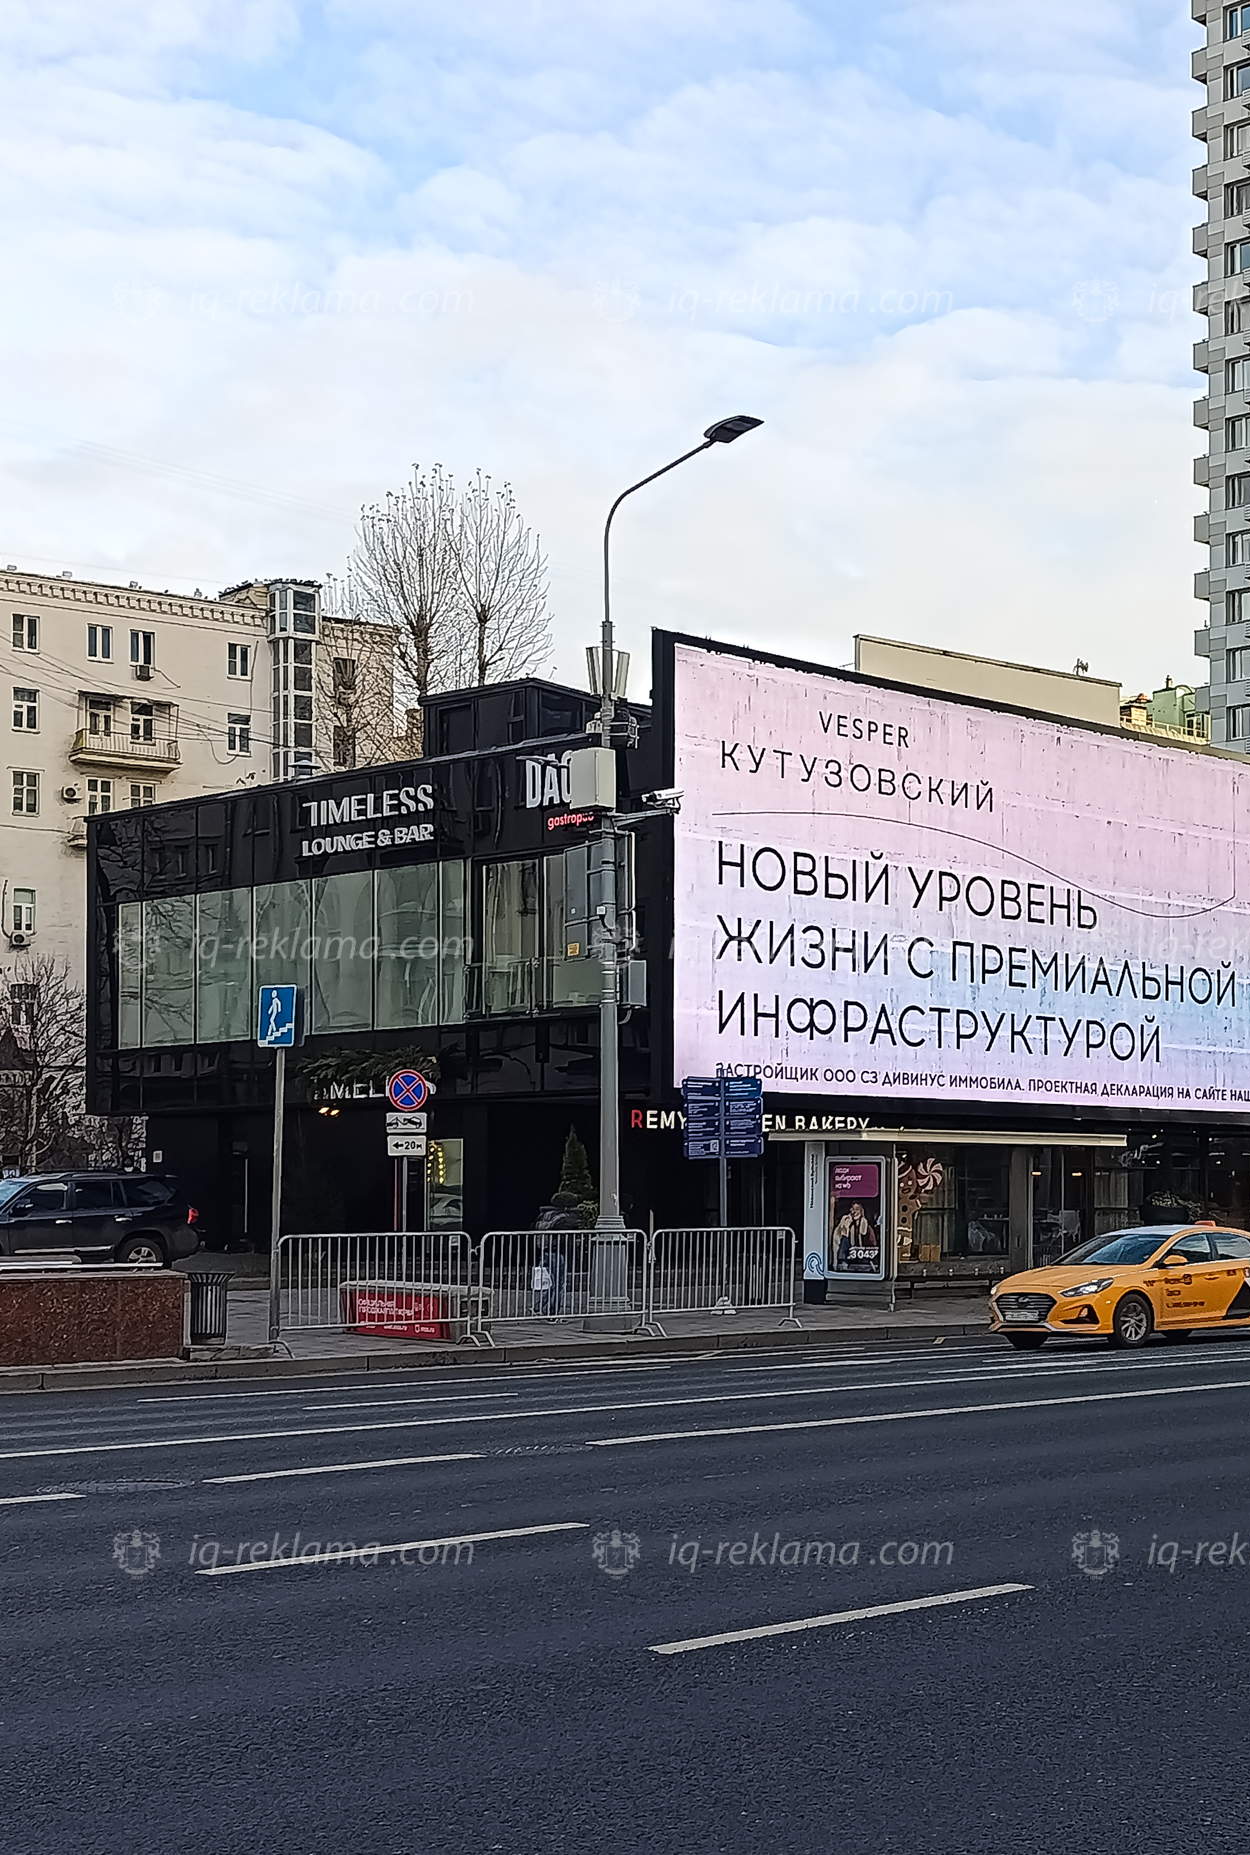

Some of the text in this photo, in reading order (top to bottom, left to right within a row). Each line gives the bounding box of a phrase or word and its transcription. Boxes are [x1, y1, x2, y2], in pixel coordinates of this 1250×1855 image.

[819, 711, 909, 748] VESPER
[720, 740, 994, 813] КУТУЗОВСКИЙ
[302, 784, 434, 827] TIMELESS
[302, 823, 435, 857] LOUNGE & BAR
[716, 839, 1098, 930] НОВЫЙ УРОВЕНЬ
[715, 914, 1238, 1008] ЖИЗНИ С ПРЕМИАЛЬНОЙ
[716, 989, 1162, 1063] ИНФРАСТРУКТУРОЙ
[823, 1068, 856, 1083] ООО
[860, 1069, 879, 1085] СЗ
[881, 1070, 947, 1088] ДИВИНУС
[949, 1074, 1025, 1092] ИММОБИЛА.
[1028, 1078, 1098, 1096] ПРОЕКТНАЯ
[1100, 1082, 1175, 1101] ДЕКЛАРАЦИЯ
[1177, 1086, 1192, 1100] НА
[1194, 1085, 1228, 1102] САЙТЕ
[631, 1109, 687, 1130] REMY
